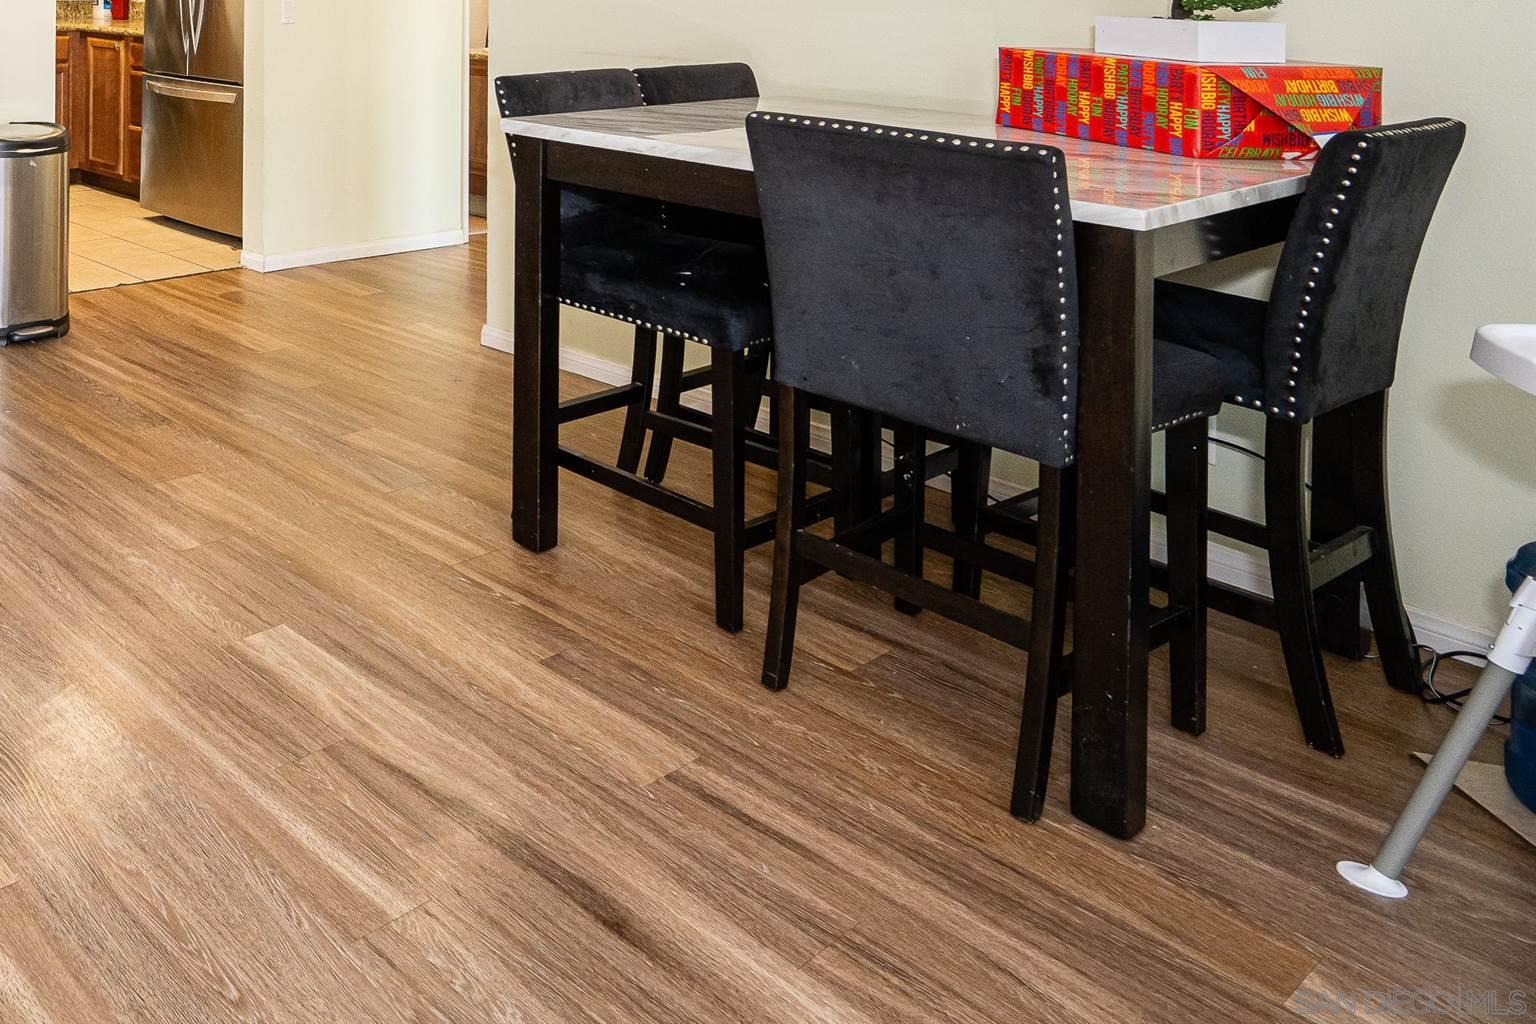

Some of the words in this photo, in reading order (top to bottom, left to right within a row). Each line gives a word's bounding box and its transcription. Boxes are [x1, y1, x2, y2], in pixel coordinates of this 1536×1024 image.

[1033, 57, 1044, 85] PARTY
[1116, 63, 1129, 96] PARTY
[1284, 79, 1339, 94] BIRTHDAY
[1000, 82, 1011, 113] HAPPY
[1012, 87, 1022, 106] FUN
[1033, 86, 1043, 118] HAPPY
[1067, 78, 1079, 117] HOORAY
[1091, 96, 1103, 116] FUN
[1217, 78, 1231, 104] ARTY
[1273, 93, 1318, 107] HOORAY
[1078, 90, 1091, 125] HAPPY
[1115, 96, 1128, 130] HAPPY
[1155, 87, 1168, 129] HOORAY
[1169, 102, 1183, 138] HAPPY
[1184, 108, 1200, 130] FUN
[1216, 104, 1231, 140] HAPPY
